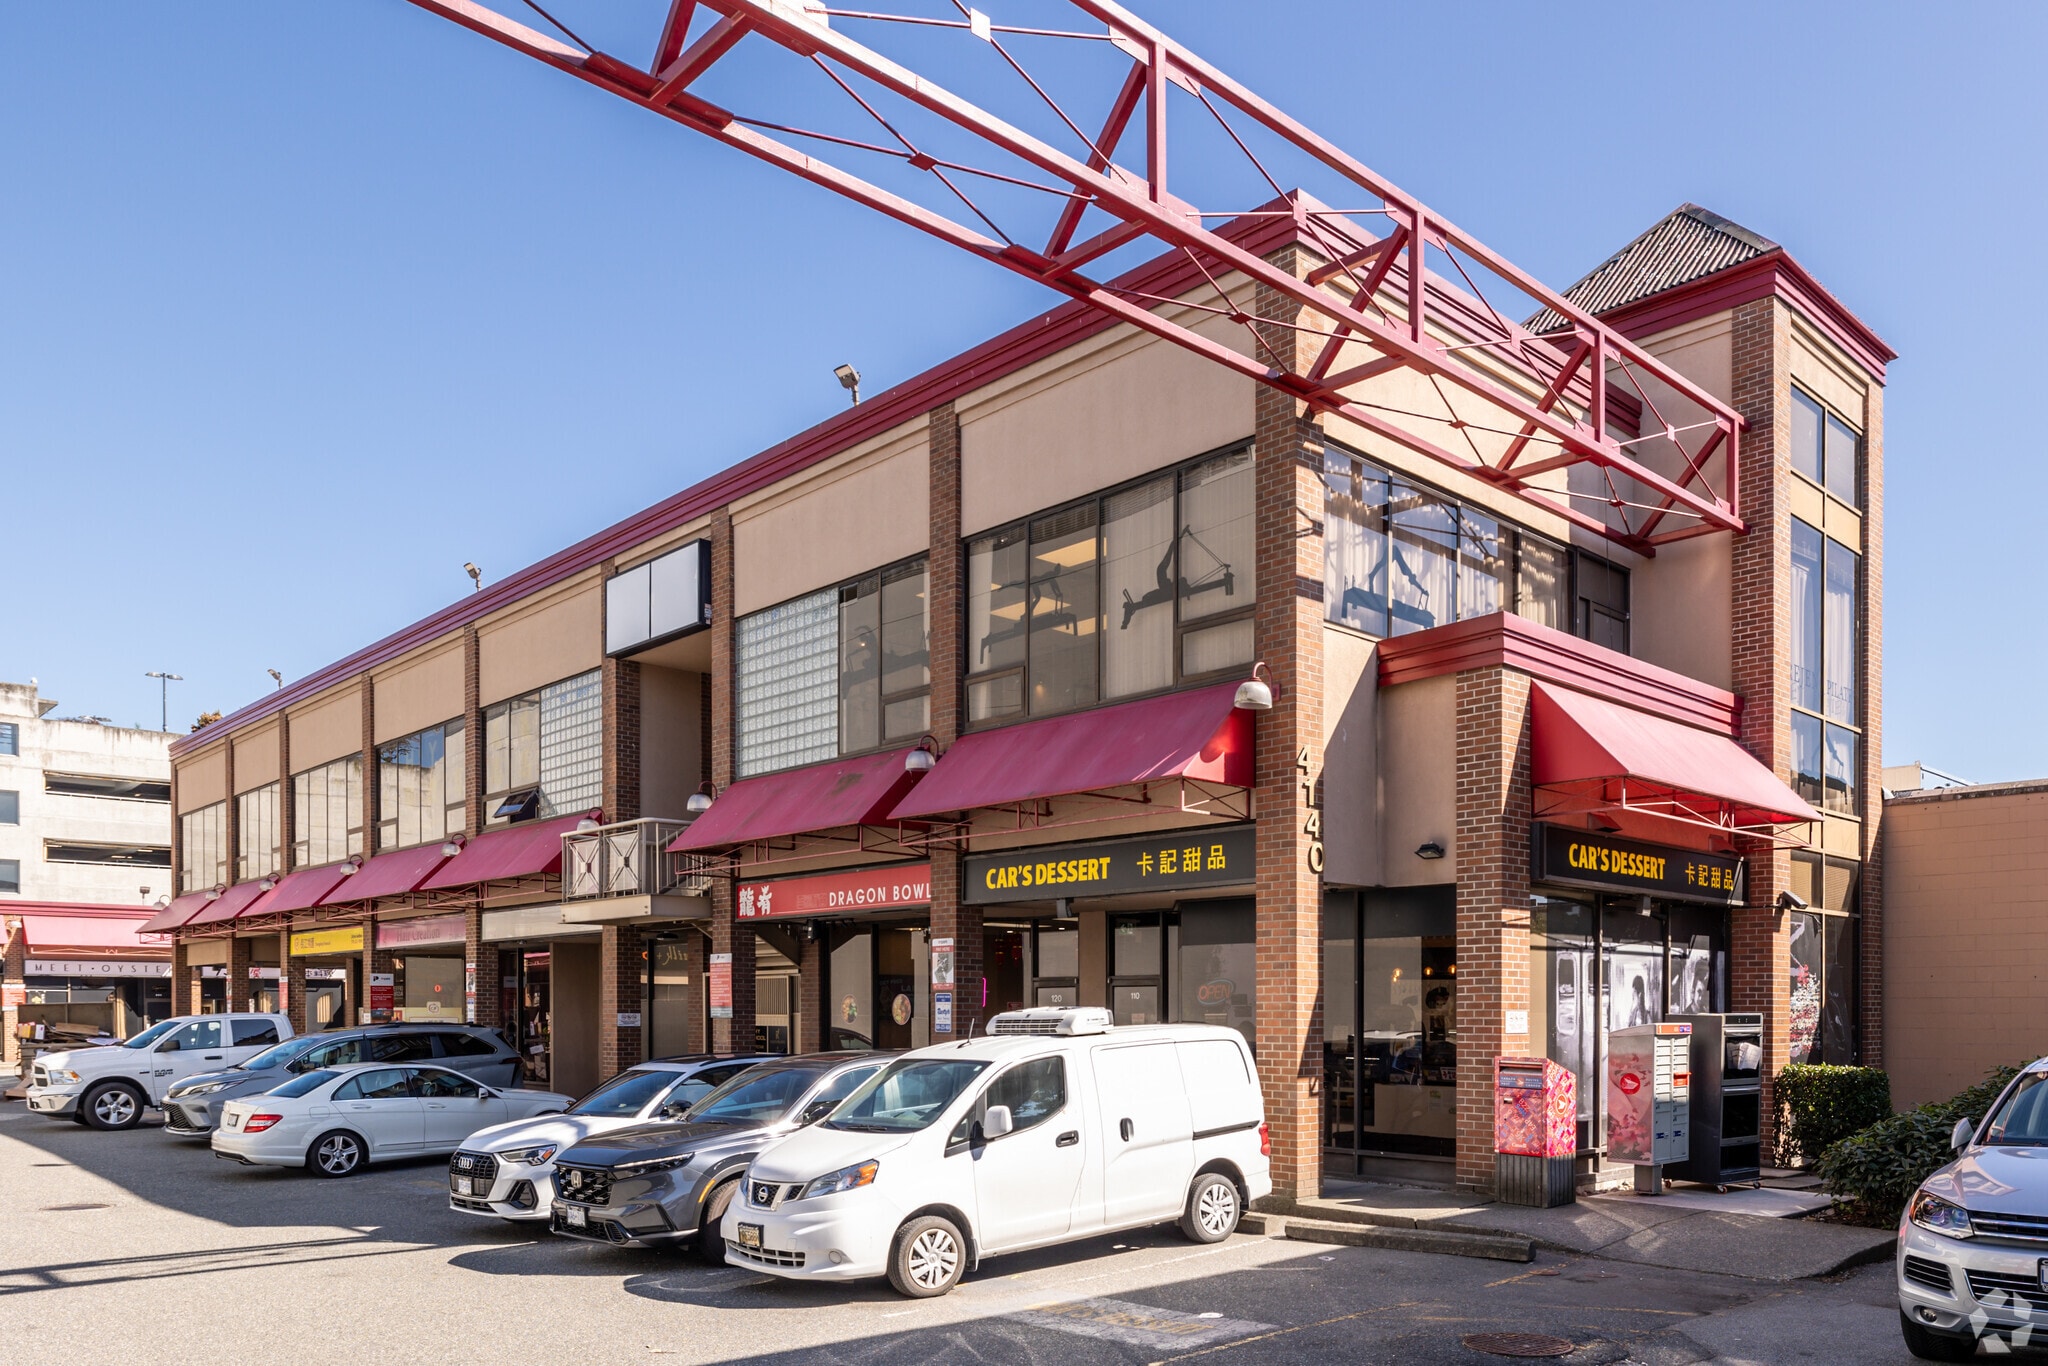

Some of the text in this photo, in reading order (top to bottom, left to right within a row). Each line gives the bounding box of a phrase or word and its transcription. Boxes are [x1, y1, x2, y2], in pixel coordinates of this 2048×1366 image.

[1296, 744, 1324, 873] 4140
[986, 856, 1111, 890] CAR'S DESSERT
[1136, 844, 1226, 877] 卡記甜品
[1568, 842, 1666, 881] CAR'S DESSERT
[1684, 861, 1734, 891] 卡記甜品
[829, 886, 886, 907] DRAGON
[893, 882, 931, 901] BOWL
[35, 963, 82, 972] MEET
[1051, 994, 1062, 1003] 120
[1130, 992, 1140, 1000] 110
[1199, 983, 1230, 1000] OPEN
